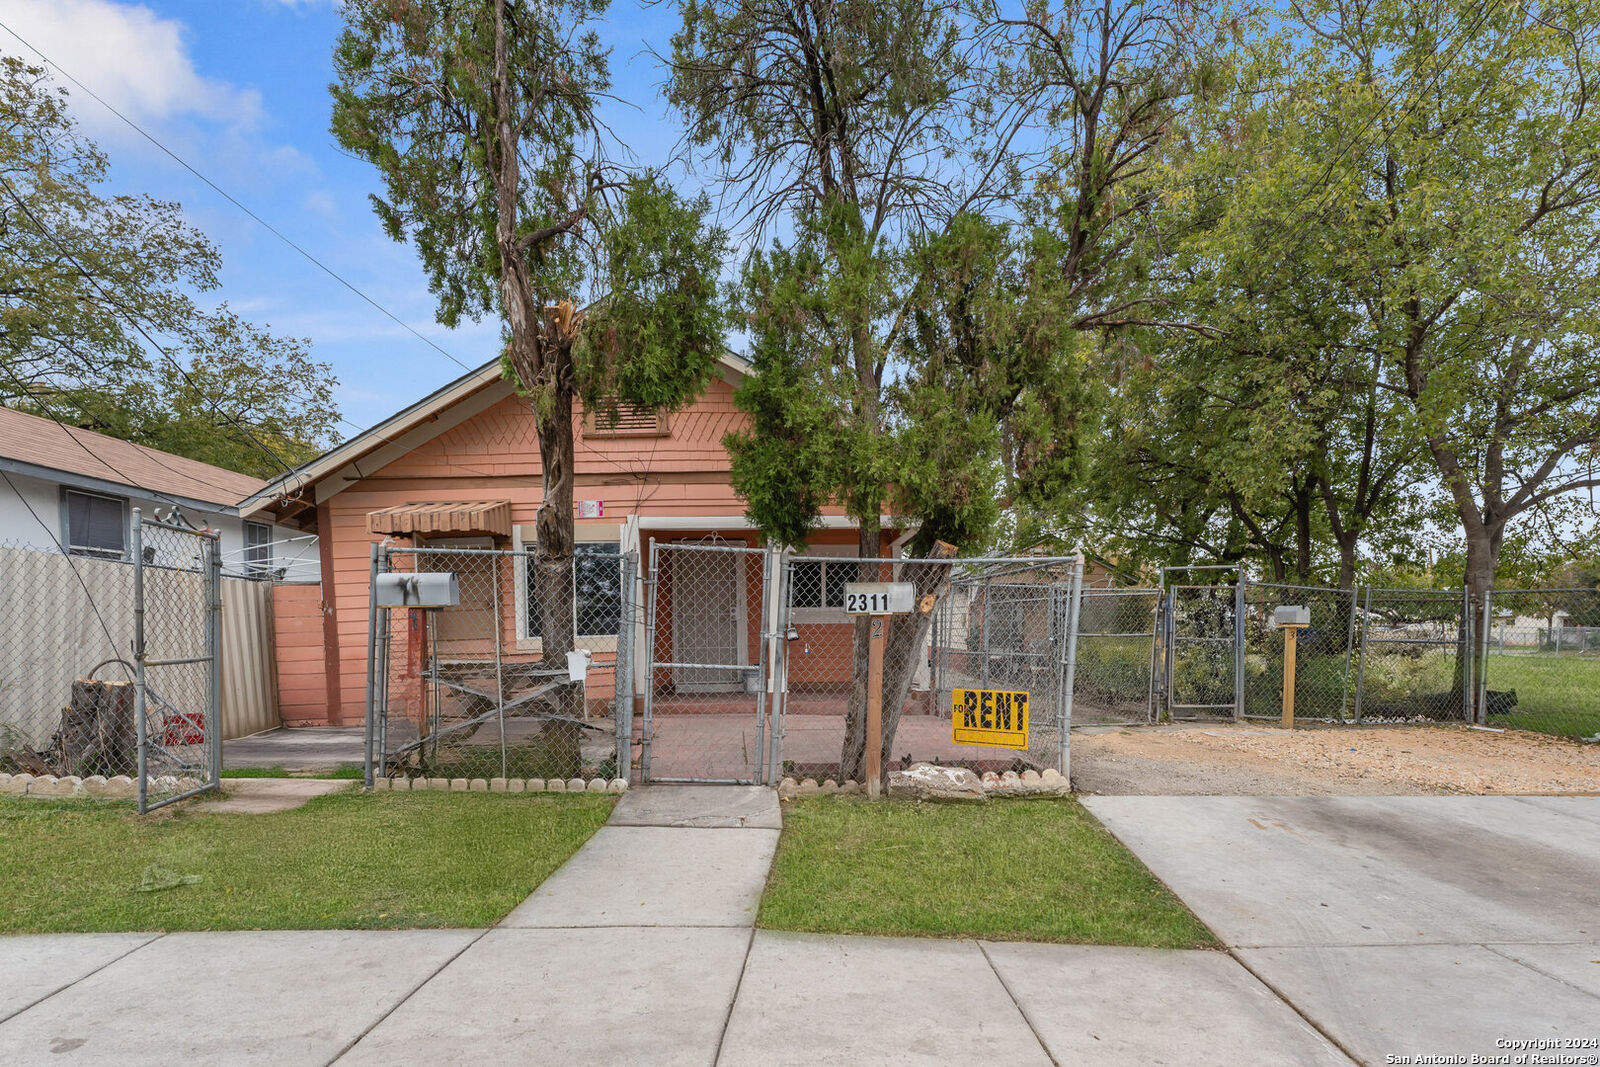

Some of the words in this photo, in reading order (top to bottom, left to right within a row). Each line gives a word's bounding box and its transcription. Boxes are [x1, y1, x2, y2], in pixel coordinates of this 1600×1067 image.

[848, 594, 888, 611] 2311
[872, 619, 883, 638] 2
[964, 691, 1027, 730] RENT
